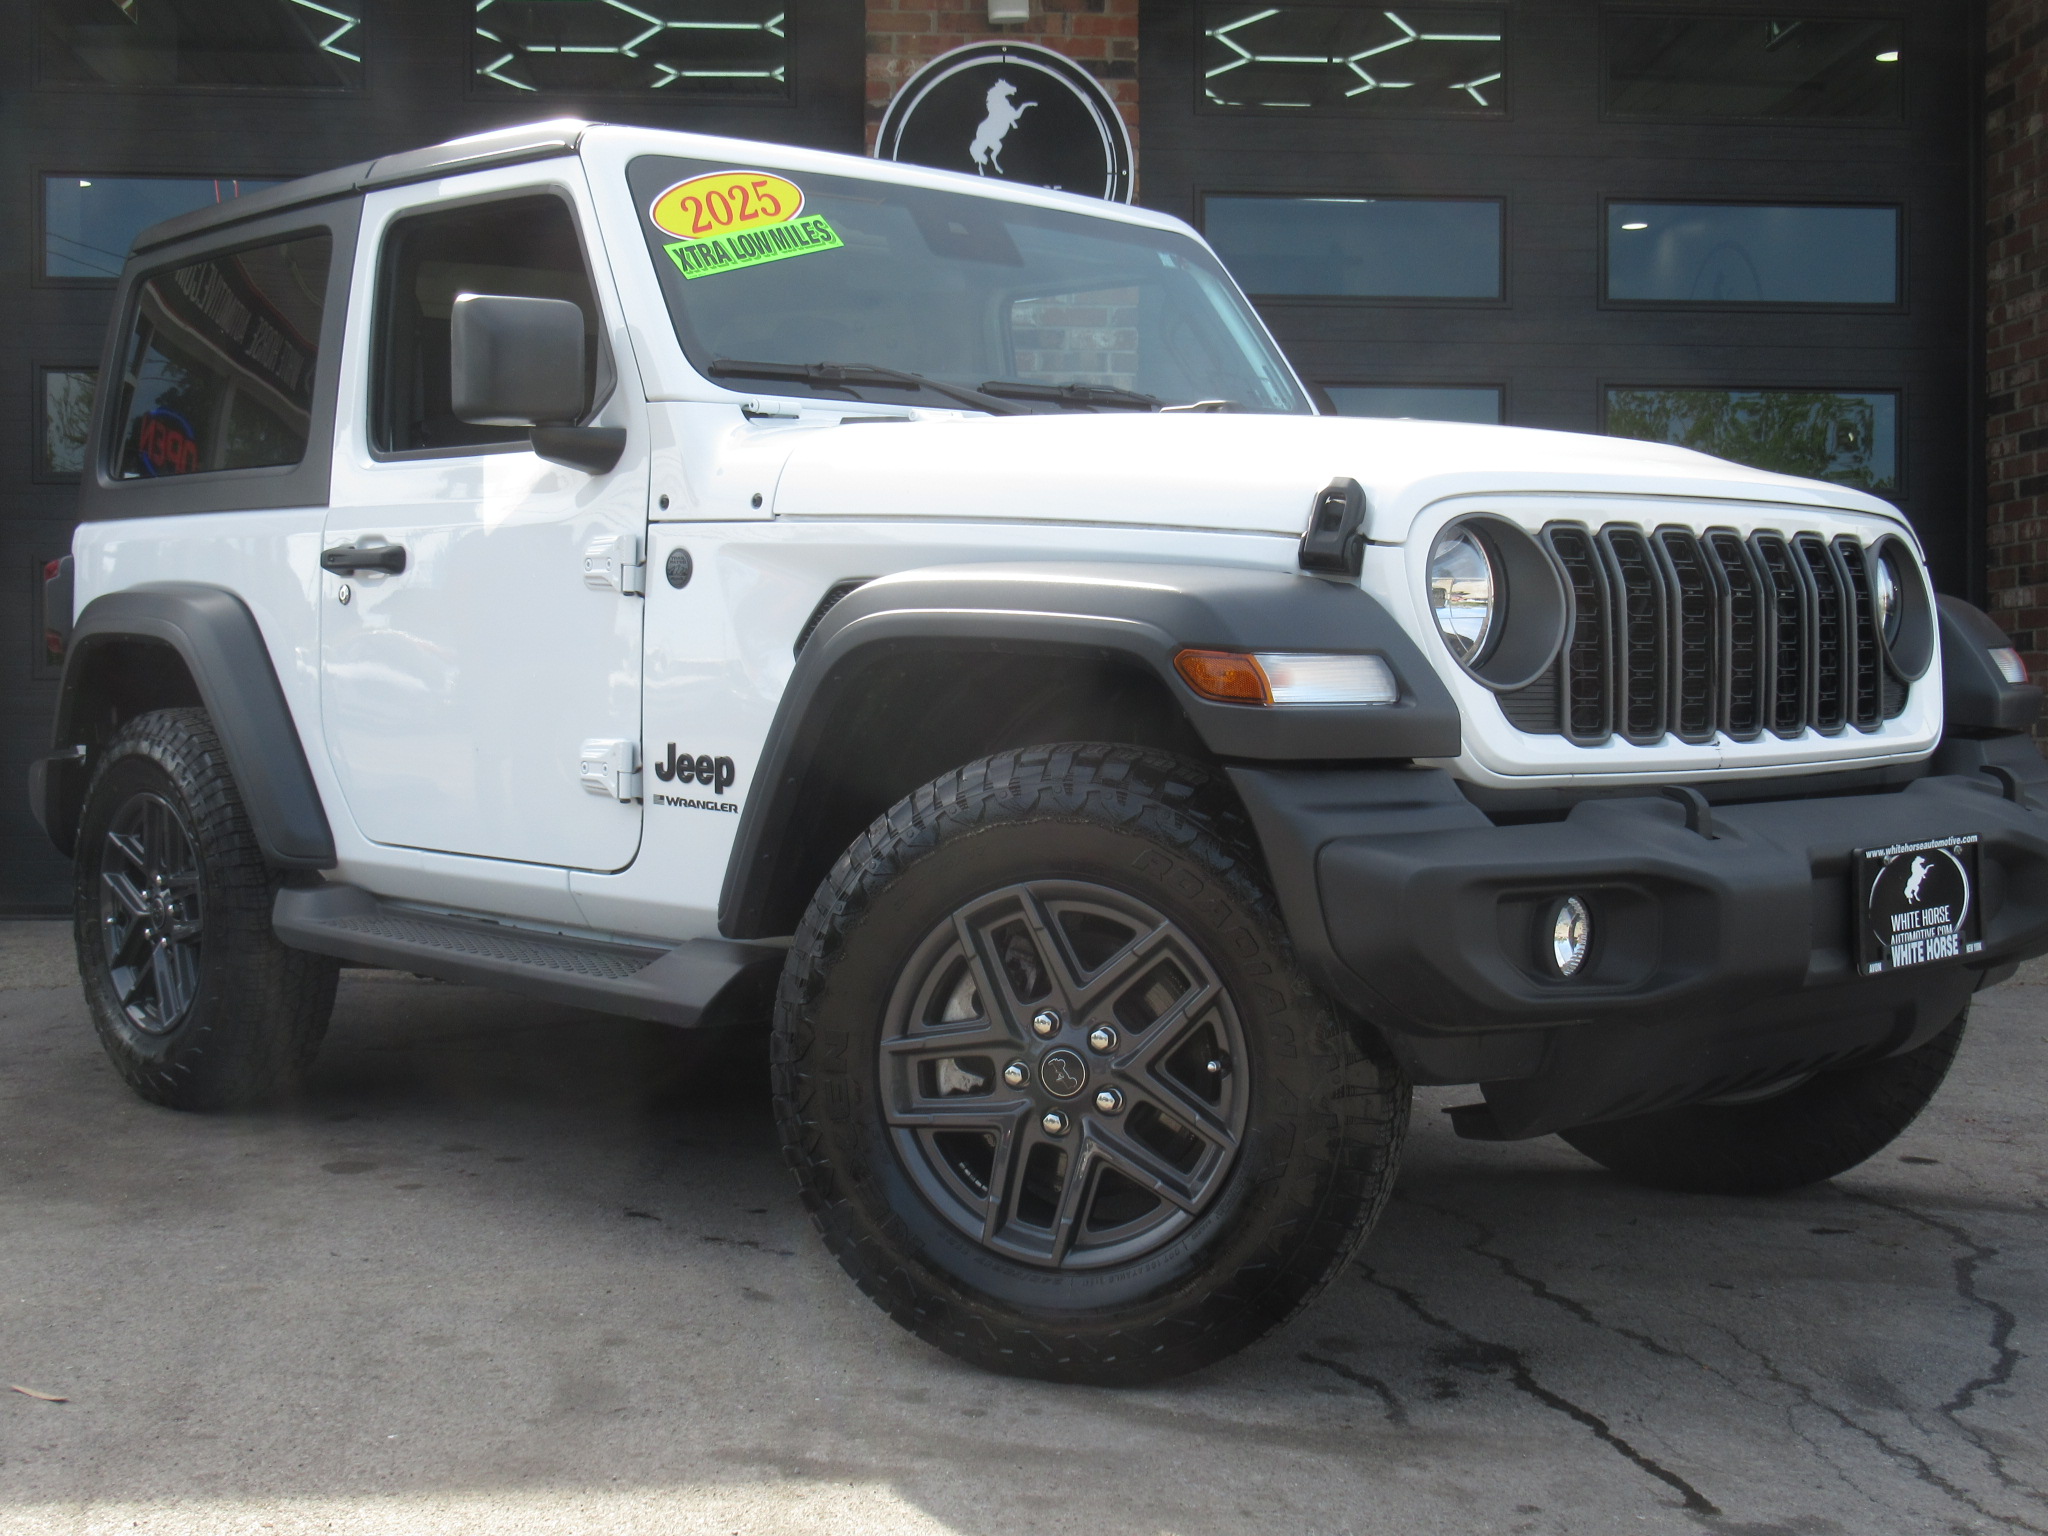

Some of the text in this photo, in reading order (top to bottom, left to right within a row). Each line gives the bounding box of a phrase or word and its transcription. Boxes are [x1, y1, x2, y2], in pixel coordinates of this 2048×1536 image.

[680, 180, 781, 233] 2025
[672, 219, 832, 273] XTRA LOW MILES
[655, 742, 735, 794] Jeep
[666, 796, 738, 814] WRANGLER
[1865, 834, 1978, 859] www.whitehorseautomotive.com
[1890, 905, 1950, 932] WHITE HORSE
[1891, 933, 1959, 968] WHITE HORSE
